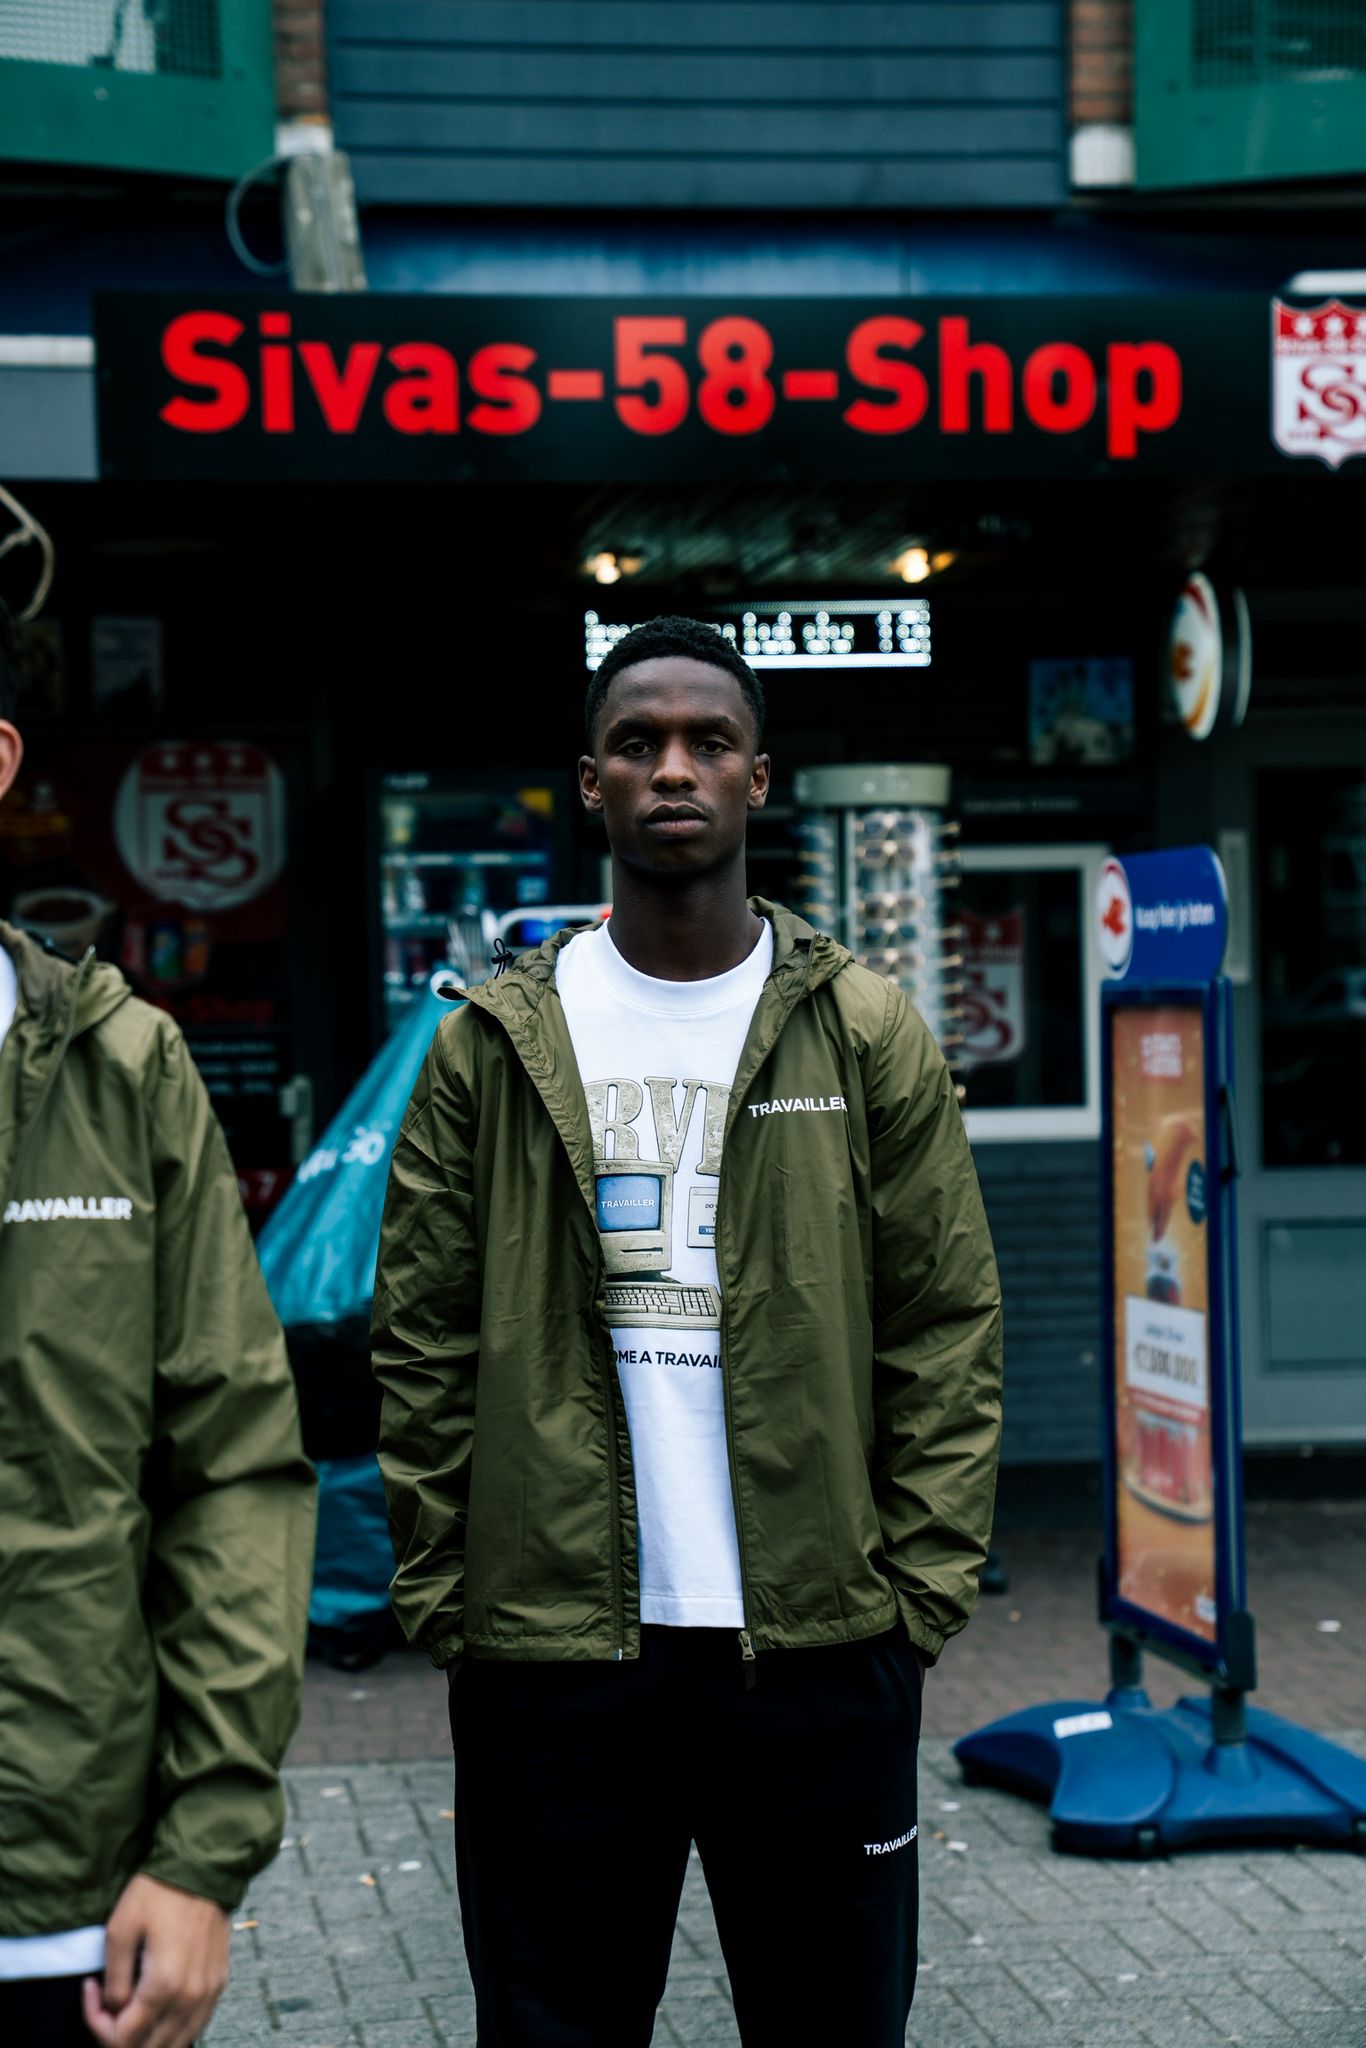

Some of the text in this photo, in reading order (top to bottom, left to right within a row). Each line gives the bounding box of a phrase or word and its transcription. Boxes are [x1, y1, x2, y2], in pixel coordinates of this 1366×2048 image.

[158, 310, 1184, 459] Sivas-58-Shop
[601, 1198, 656, 1209] TRAVAILLER
[614, 1350, 638, 1364] ME
[639, 1350, 653, 1364] A
[863, 1824, 918, 1856] TRAVAILLER
